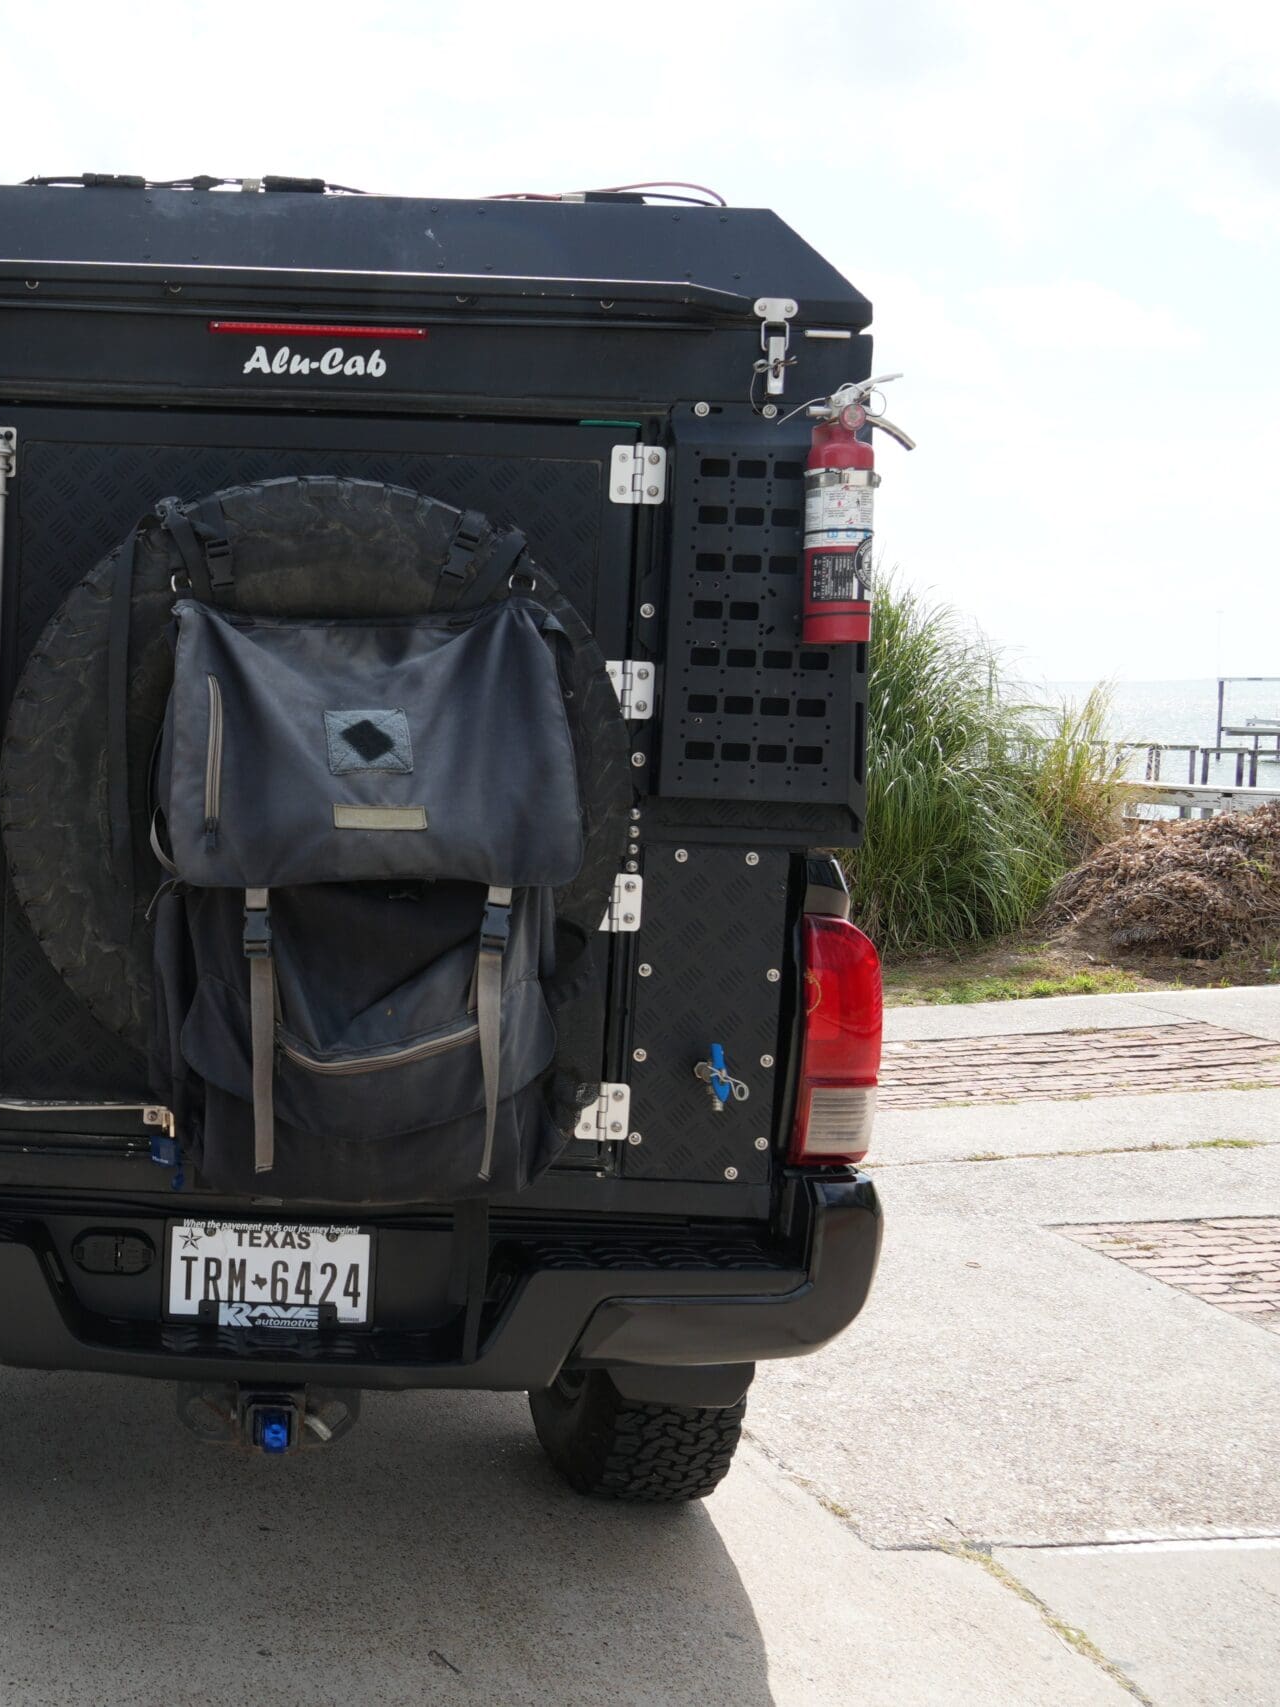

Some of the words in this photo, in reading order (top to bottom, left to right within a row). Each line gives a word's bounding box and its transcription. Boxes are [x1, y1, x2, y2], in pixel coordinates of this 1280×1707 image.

[243, 346, 387, 377] Alu-Cab
[183, 1218, 206, 1229] When
[207, 1219, 221, 1230] the
[221, 1221, 262, 1233] pavement
[263, 1222, 282, 1232] ends
[283, 1224, 298, 1233] our
[296, 1224, 330, 1236] journey
[330, 1224, 360, 1236] begins!
[234, 1230, 312, 1250] TEXAS
[270, 1259, 361, 1308] 6424
[254, 1318, 319, 1329] automotive
